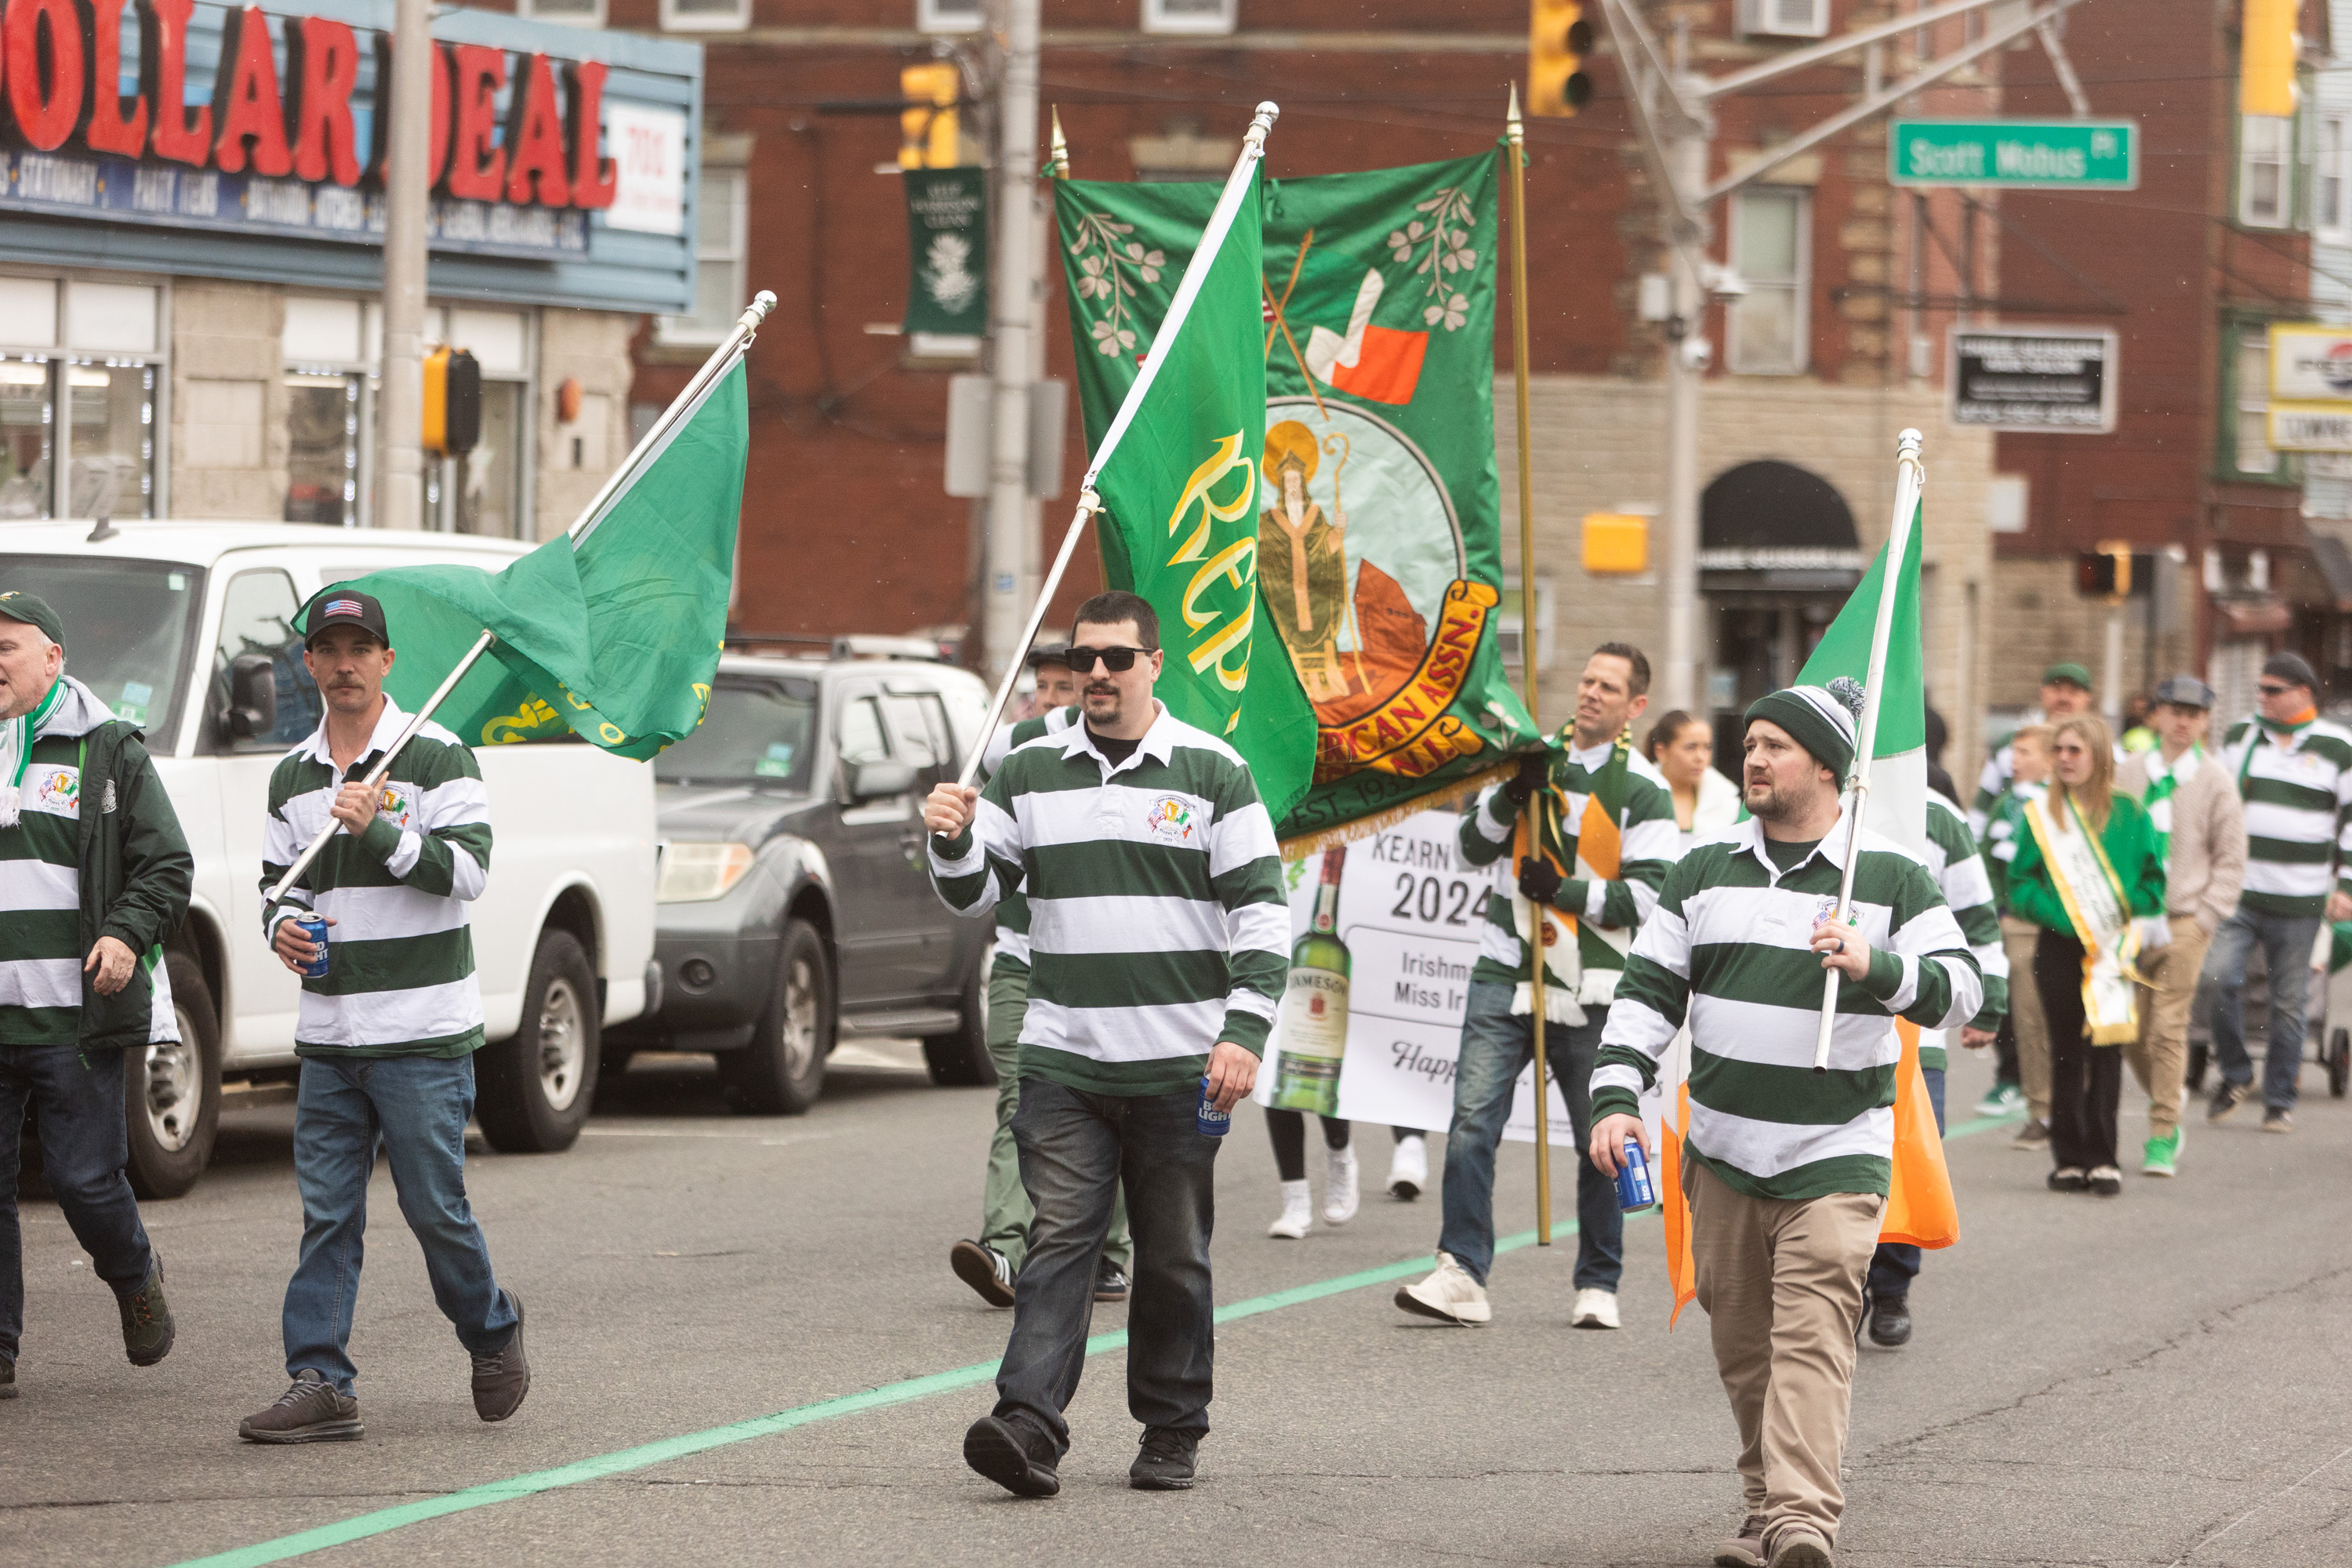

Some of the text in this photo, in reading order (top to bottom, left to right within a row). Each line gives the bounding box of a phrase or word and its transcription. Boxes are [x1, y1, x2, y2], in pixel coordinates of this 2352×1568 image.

[2, 0, 361, 187] OLLAR
[1911, 138, 1984, 176] Scott
[1167, 428, 1256, 735] REP
[1417, 610, 1479, 706] ASSN.
[1291, 775, 1411, 828] EST. 193
[1372, 832, 1450, 873] KEARN
[1391, 872, 1493, 927] 2024
[1402, 952, 1475, 982] Irishm
[1395, 982, 1465, 1011] Miss Ir
[1392, 1041, 1458, 1085] Happ
